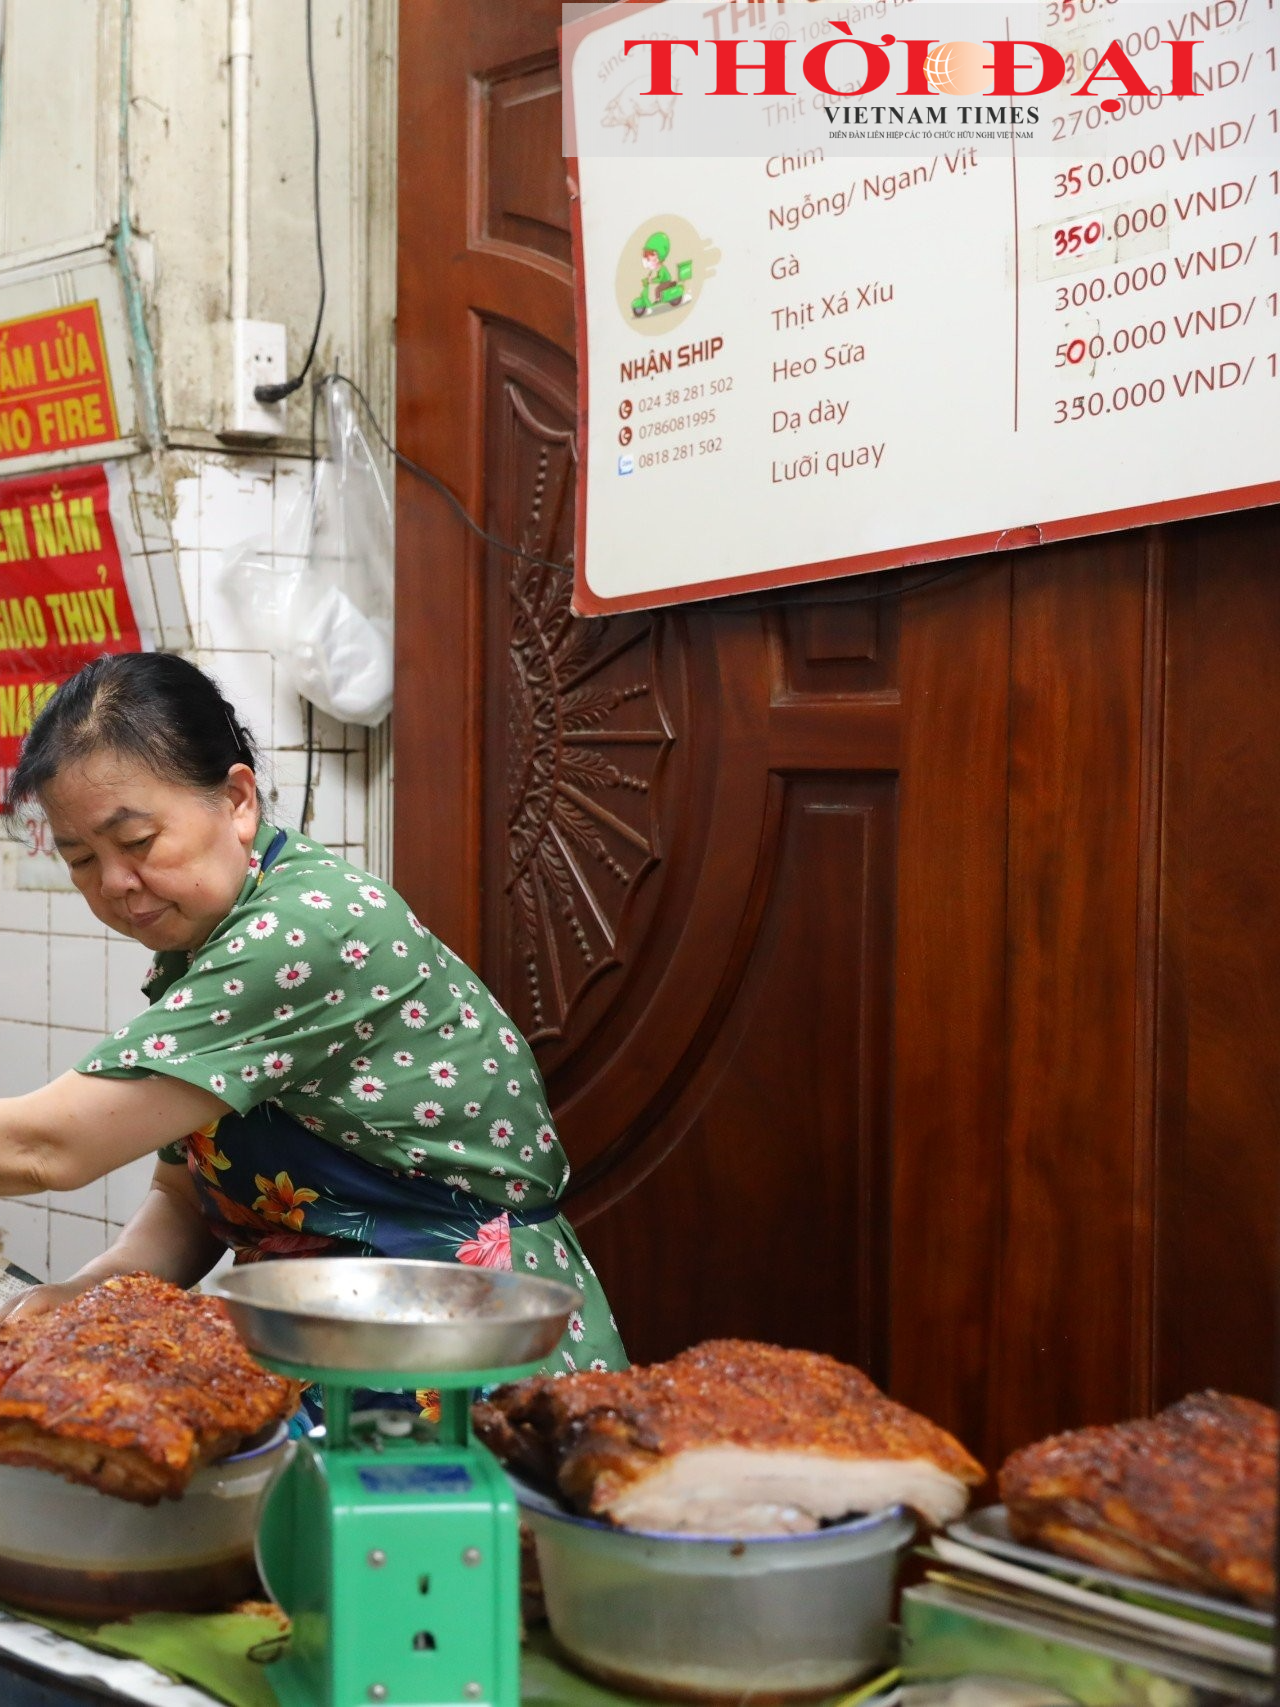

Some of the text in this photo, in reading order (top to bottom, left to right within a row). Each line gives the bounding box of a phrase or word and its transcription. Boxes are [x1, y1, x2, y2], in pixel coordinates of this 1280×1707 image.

[1171, 53, 1253, 101] ND/
[766, 146, 824, 178] Chim
[1054, 144, 1166, 198] 350.000
[1173, 114, 1256, 161] VND/
[768, 146, 978, 230] Ngỗng/ Ngan/ Vịt
[1054, 203, 1167, 256] 350.000
[1174, 175, 1257, 221] VND/
[771, 254, 800, 280] Gà
[1055, 262, 1166, 311] 300.000
[1174, 236, 1257, 280] VND/
[771, 281, 894, 331] Thịt Xá Xíu
[40, 320, 96, 382] LỬA
[1054, 320, 1166, 368] 500.000
[1173, 296, 1256, 339] VND/
[620, 336, 724, 383] NHẬN SHIP
[773, 343, 865, 382] Heo Sữa
[638, 396, 661, 413] 024
[683, 384, 705, 402] 281
[710, 376, 733, 395] 502
[1053, 379, 1166, 424] 350.000
[1173, 356, 1255, 397] VND/
[37, 393, 106, 445] FIRE
[638, 409, 716, 439] 0786081995
[772, 399, 849, 434] Dạ dày
[638, 449, 669, 468] 0818
[673, 443, 694, 461] 281
[699, 437, 722, 455] 502
[772, 442, 885, 483] Lưỡi quay
